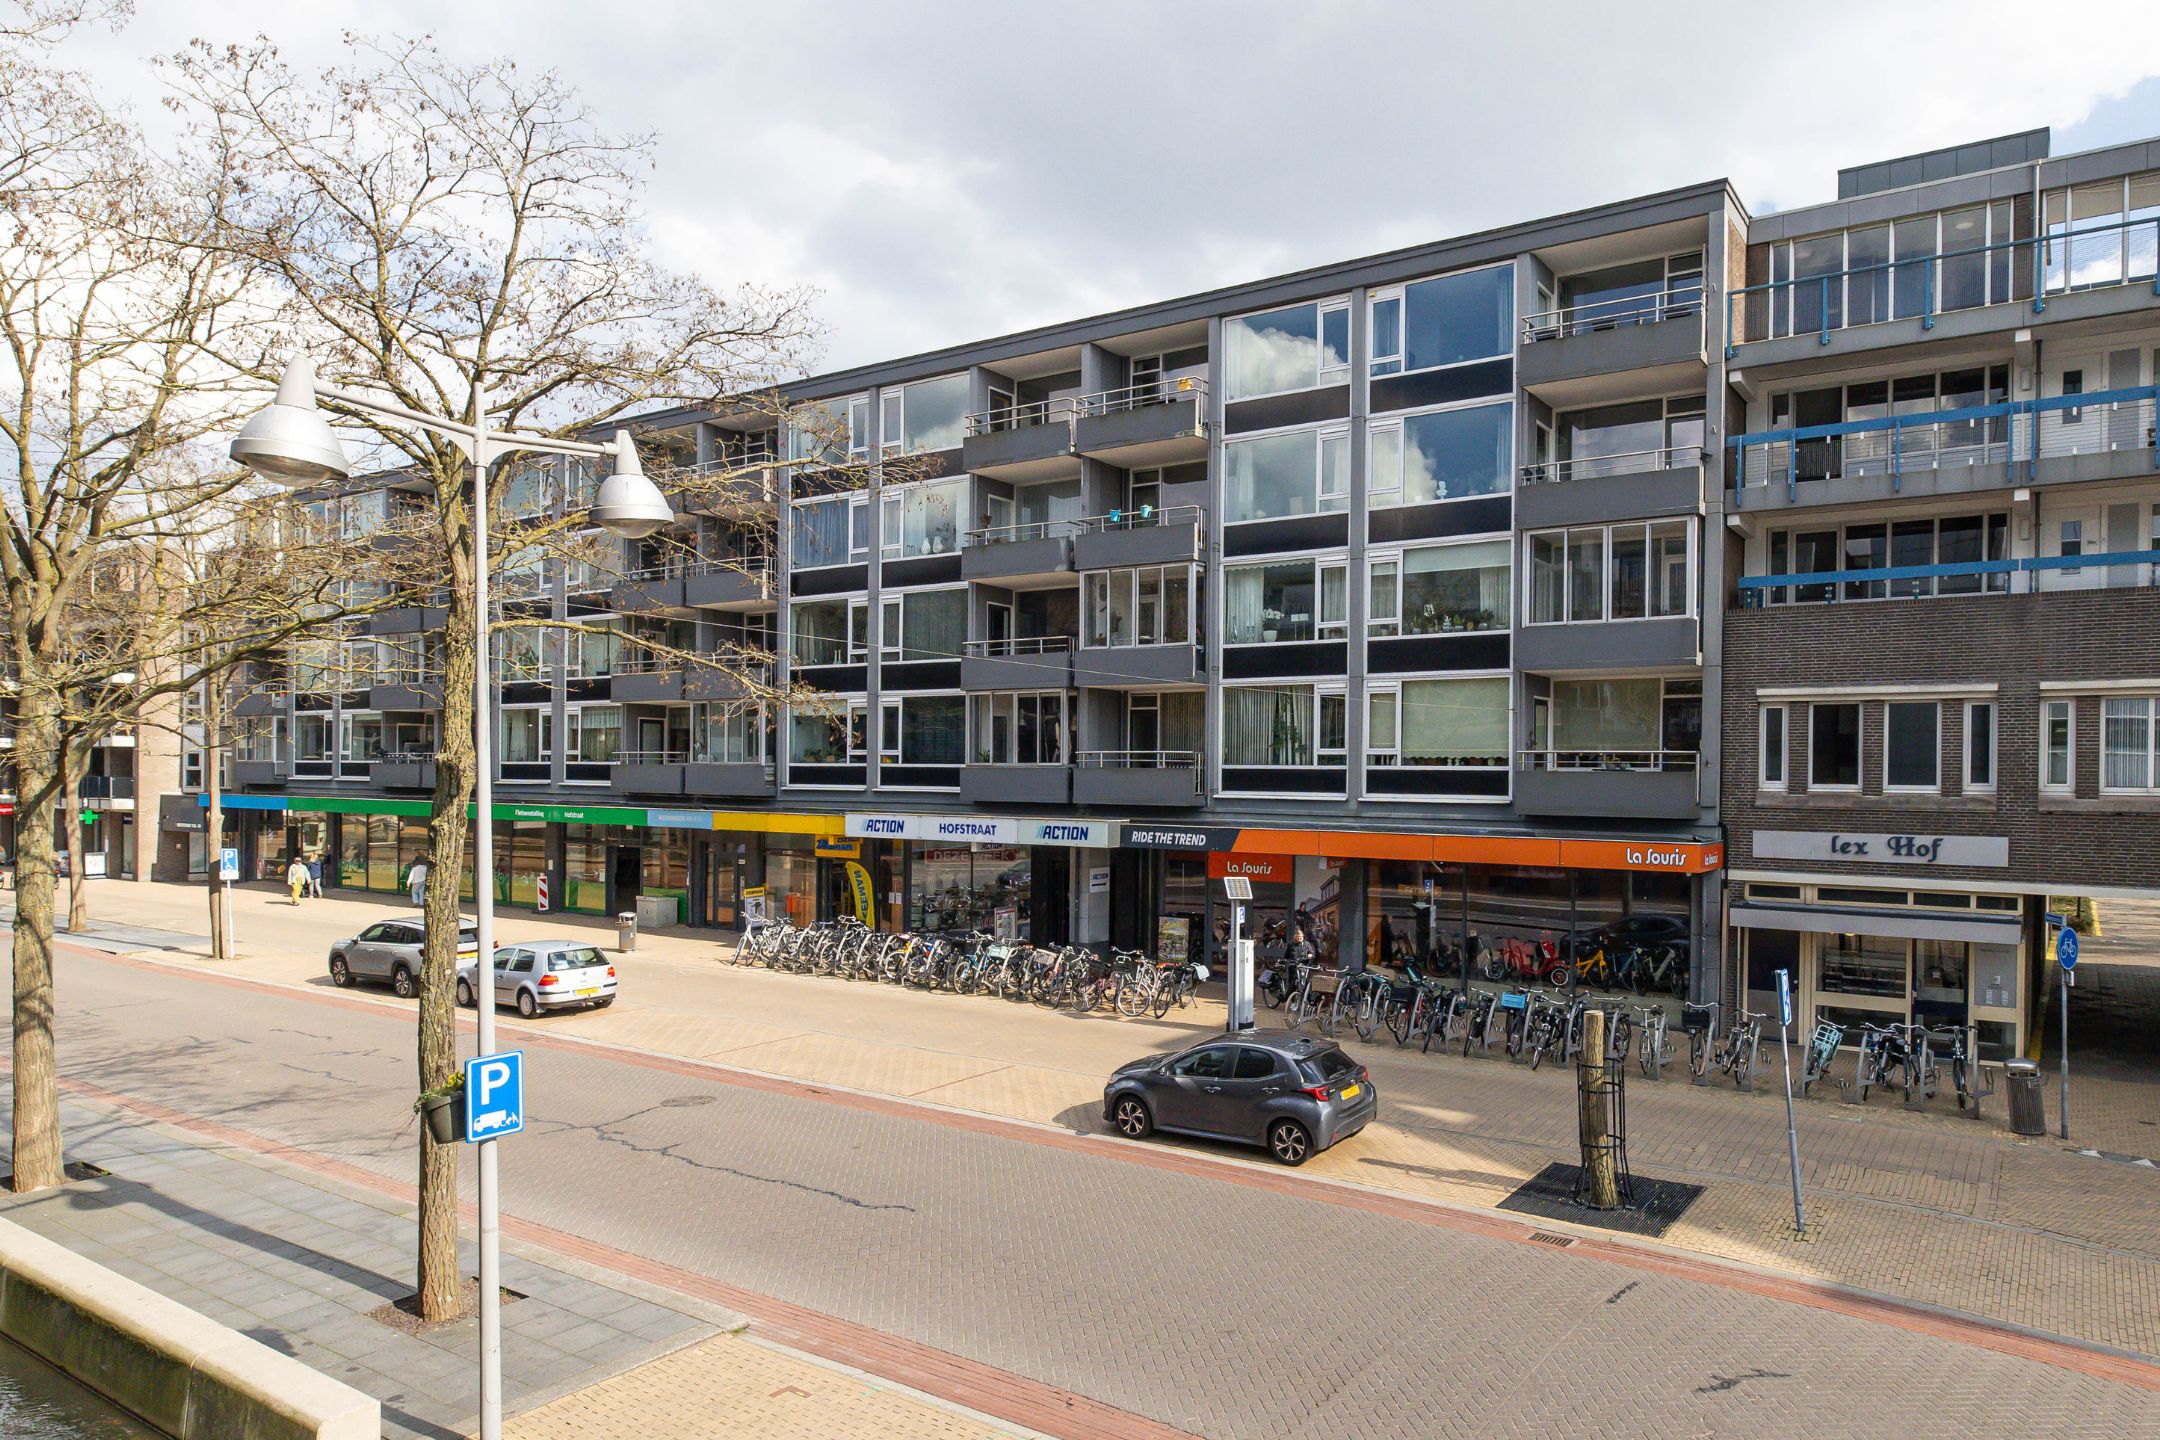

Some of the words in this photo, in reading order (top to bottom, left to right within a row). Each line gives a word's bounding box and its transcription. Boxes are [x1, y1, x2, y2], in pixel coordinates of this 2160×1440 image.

[865, 819, 905, 833] ACTION
[939, 823, 997, 836] HOFSTRAAT
[1042, 825, 1089, 840] ACTION
[1132, 831, 1153, 844] RIDE
[1155, 832, 1173, 845] THE
[1174, 833, 1206, 846] TREND
[224, 850, 234, 862] P
[933, 850, 969, 862] DEZE
[1887, 836, 1944, 862] Hof
[1627, 847, 1642, 864] La
[1645, 848, 1687, 866] Souris
[1227, 861, 1238, 873] La
[1240, 861, 1272, 875] Souris
[481, 1062, 510, 1105] P
